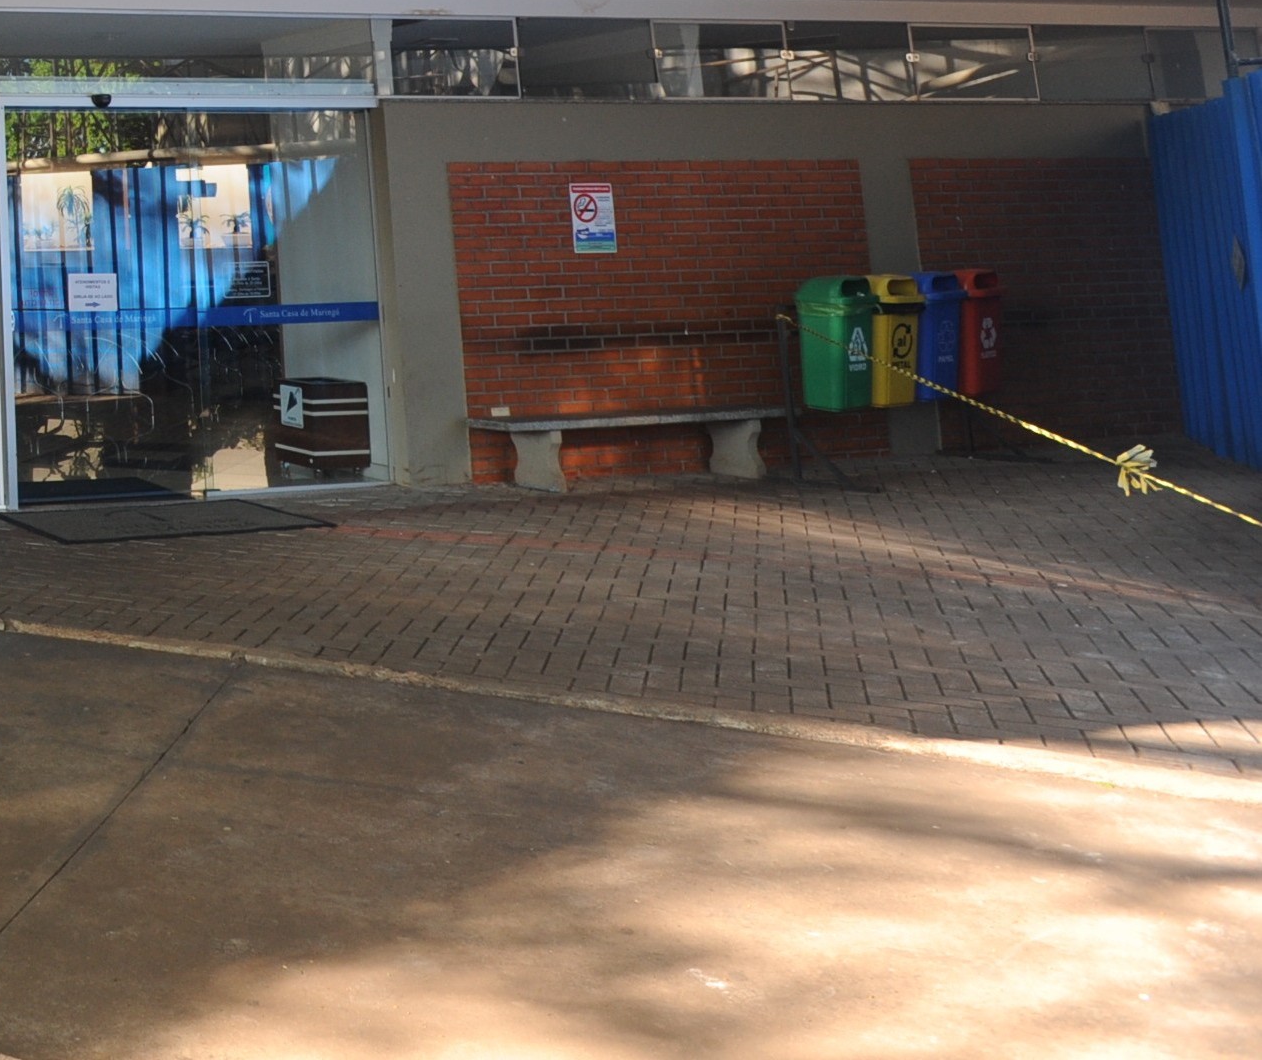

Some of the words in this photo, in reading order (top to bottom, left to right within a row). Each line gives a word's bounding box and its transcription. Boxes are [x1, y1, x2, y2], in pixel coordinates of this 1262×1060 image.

[260, 310, 280, 318] Santa
[281, 309, 299, 318] Casa
[300, 308, 309, 317] de
[71, 315, 93, 324] Santa
[94, 315, 112, 324] Casa
[848, 363, 867, 372] VIDRO
